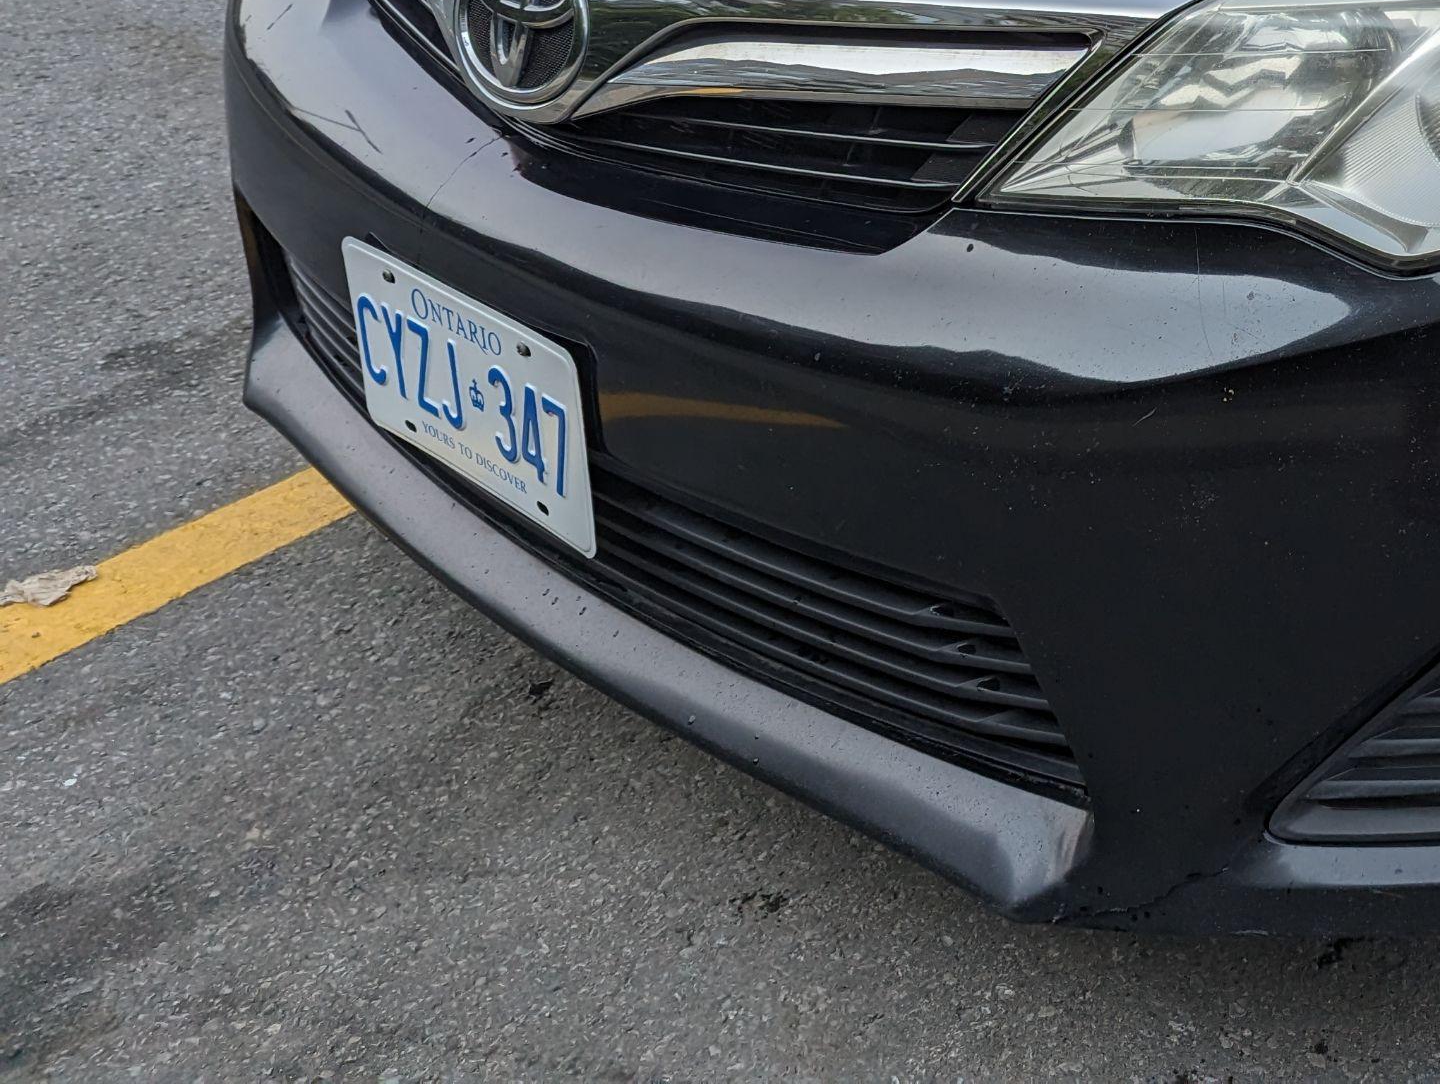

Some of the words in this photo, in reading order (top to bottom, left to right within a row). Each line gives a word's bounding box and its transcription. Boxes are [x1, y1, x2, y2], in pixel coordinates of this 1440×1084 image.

[411, 288, 502, 356] ONTARIO
[357, 294, 464, 430] CYZJ
[488, 366, 567, 498] 347
[422, 420, 456, 449] YOURS
[458, 442, 473, 460] TO
[475, 453, 528, 494] DISCOVER
